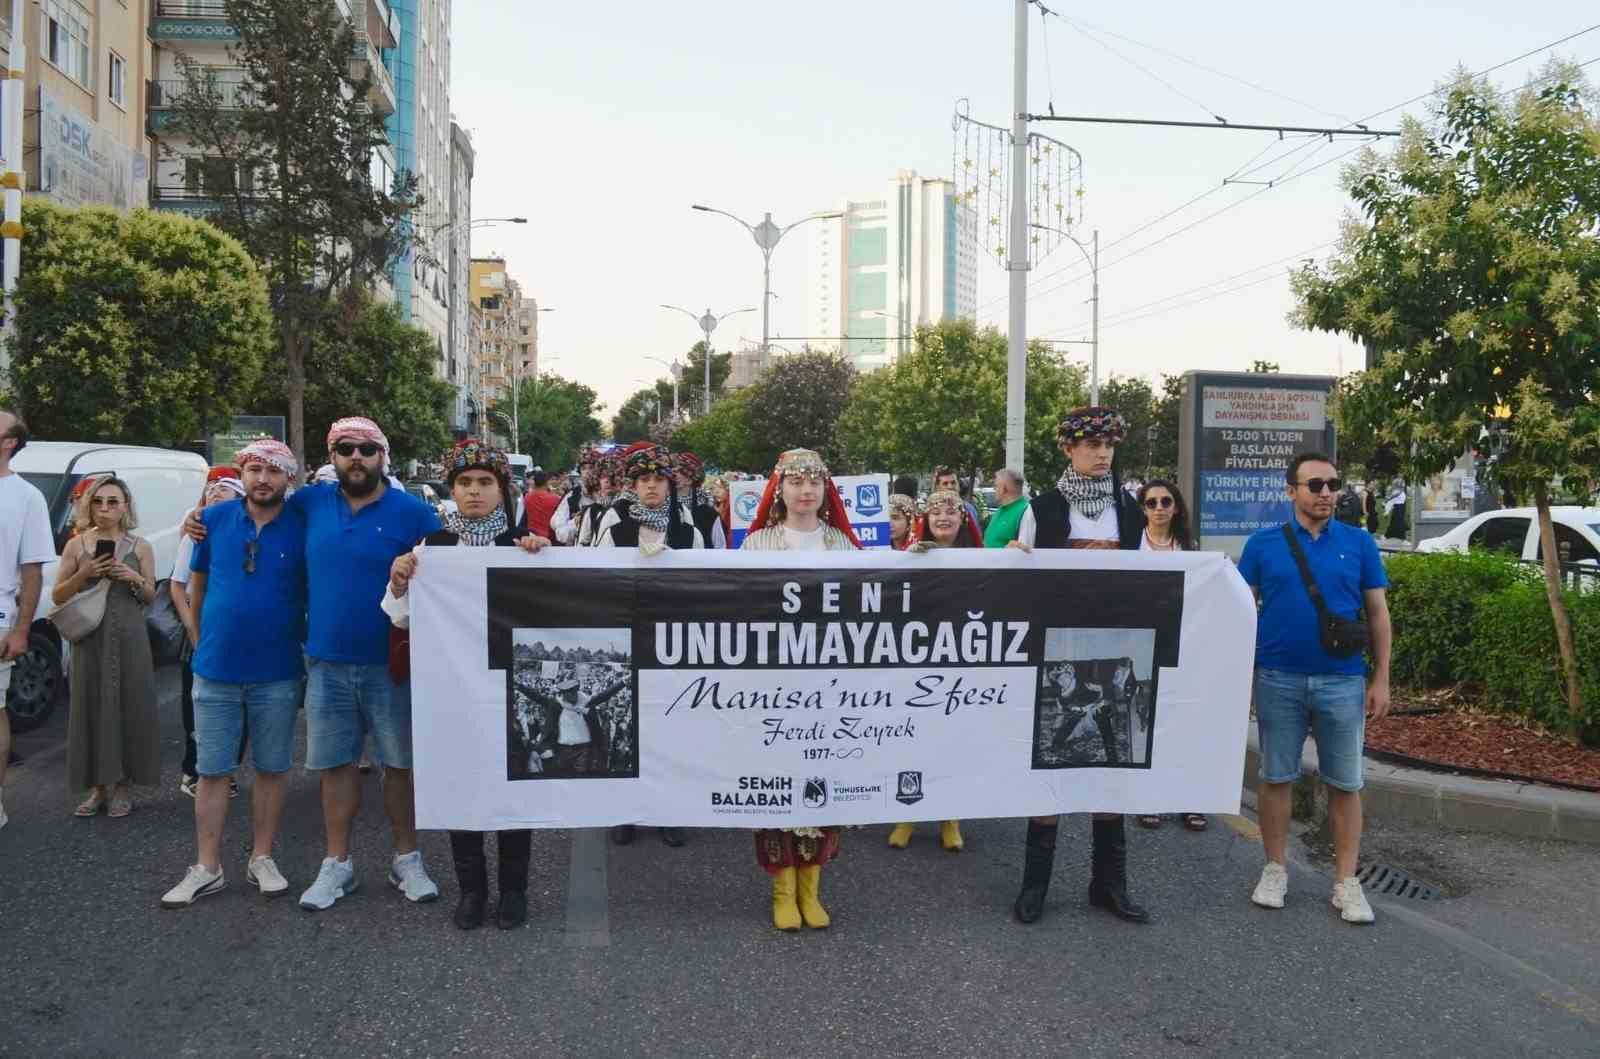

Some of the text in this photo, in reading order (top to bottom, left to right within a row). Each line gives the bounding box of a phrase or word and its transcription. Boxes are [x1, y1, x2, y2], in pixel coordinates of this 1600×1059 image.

[1220, 430, 1259, 441] 12.500
[1230, 444, 1294, 456] BAŞLAYAN
[1225, 456, 1289, 469] FİYATLARL
[1206, 474, 1259, 488] TÜRKİYE
[1206, 490, 1254, 502] KATILIM
[655, 610, 1030, 665] UNUTMAYACAĞIZ
[665, 675, 1008, 716] Manisa'nın Efesi
[762, 716, 915, 747] Ferdi Zeyrek
[711, 792, 792, 806] BALABAN
